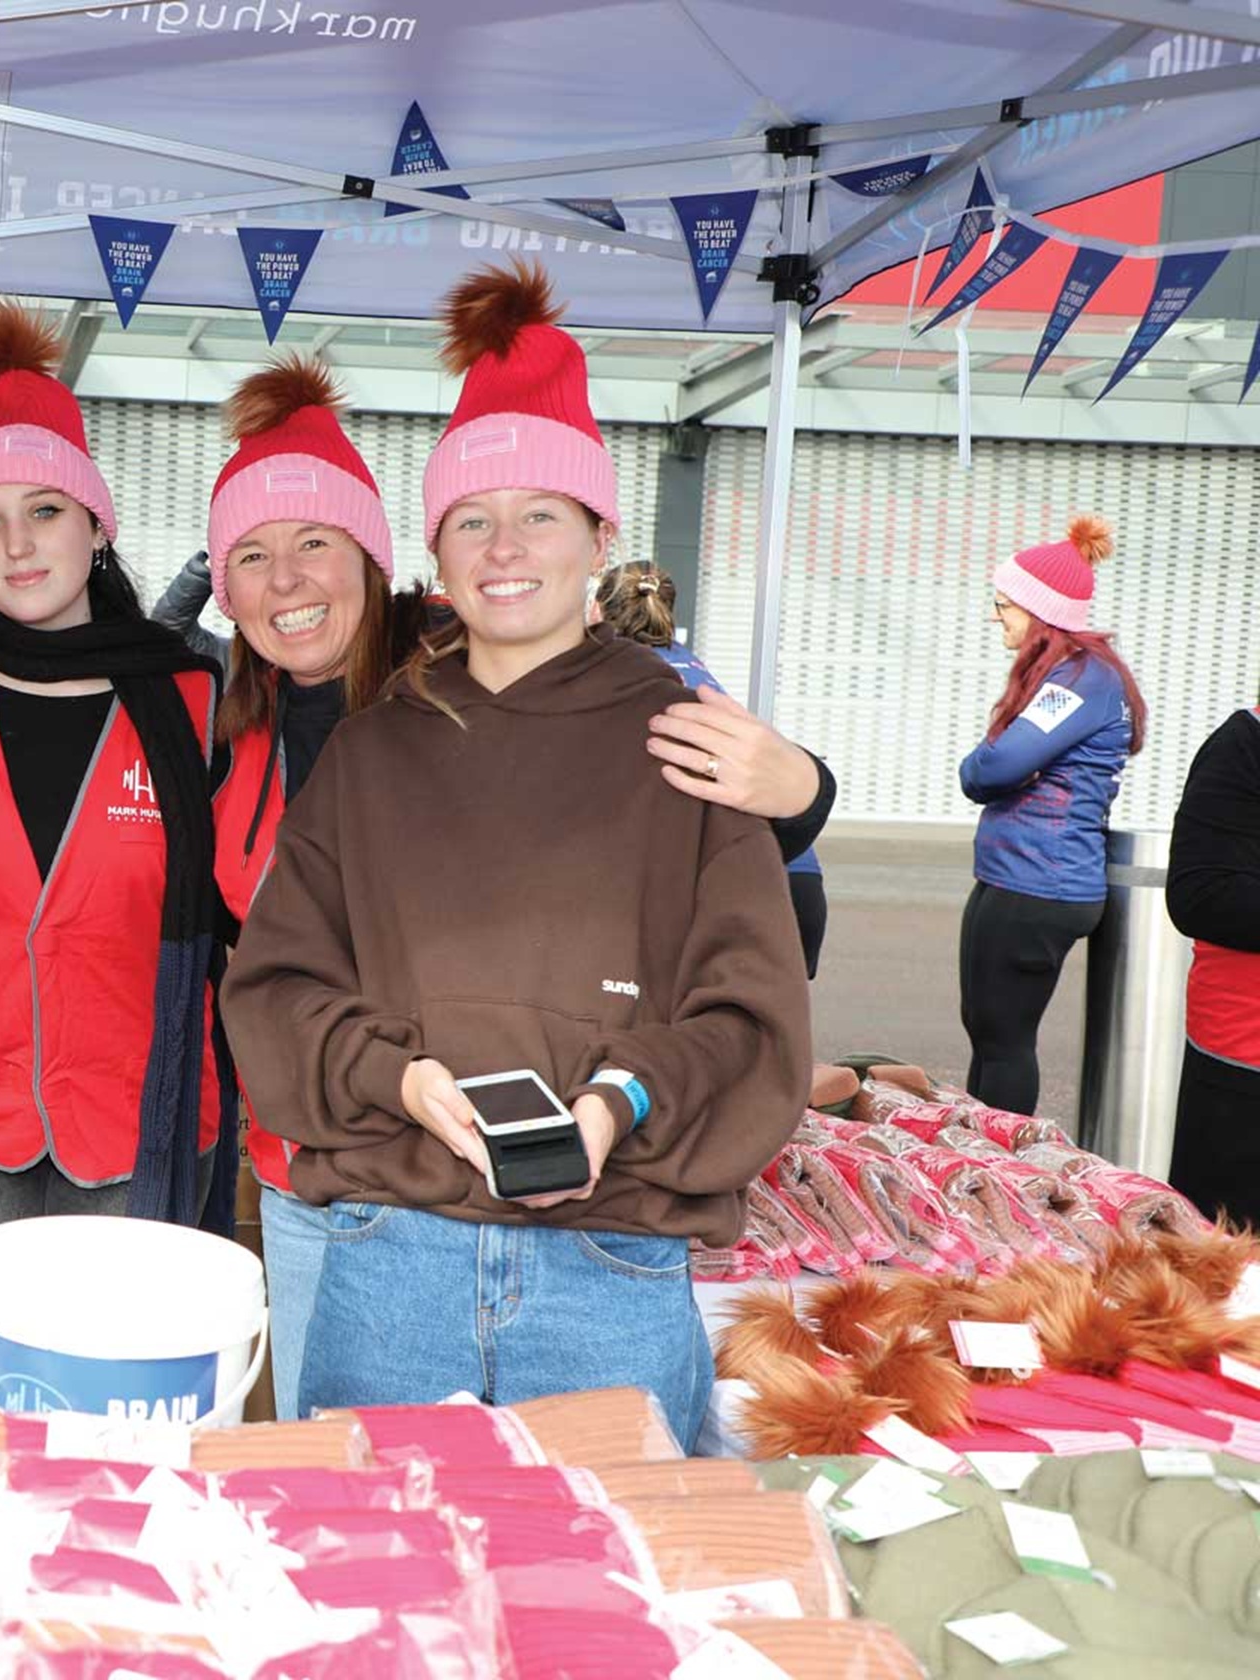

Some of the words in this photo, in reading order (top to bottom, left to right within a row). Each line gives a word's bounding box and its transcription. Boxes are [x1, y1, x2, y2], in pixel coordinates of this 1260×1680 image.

[696, 221, 713, 230] YOU
[713, 220, 735, 229] HAVE
[693, 230, 709, 240] THE
[709, 229, 738, 239] POWER
[111, 241, 128, 251] YOU
[128, 242, 151, 253] HAVE
[699, 240, 710, 249] TO
[710, 239, 732, 249] BEAT
[108, 249, 124, 259] THE
[124, 251, 153, 262] POWER
[259, 252, 276, 262] YOU
[276, 253, 298, 263] HAVE
[113, 258, 124, 267] TO
[125, 259, 146, 269] BEAT
[255, 261, 272, 271] THE
[272, 261, 300, 271] POWER
[261, 271, 272, 280] TO
[272, 270, 293, 280] BEAT
[107, 806, 138, 817] MARK
